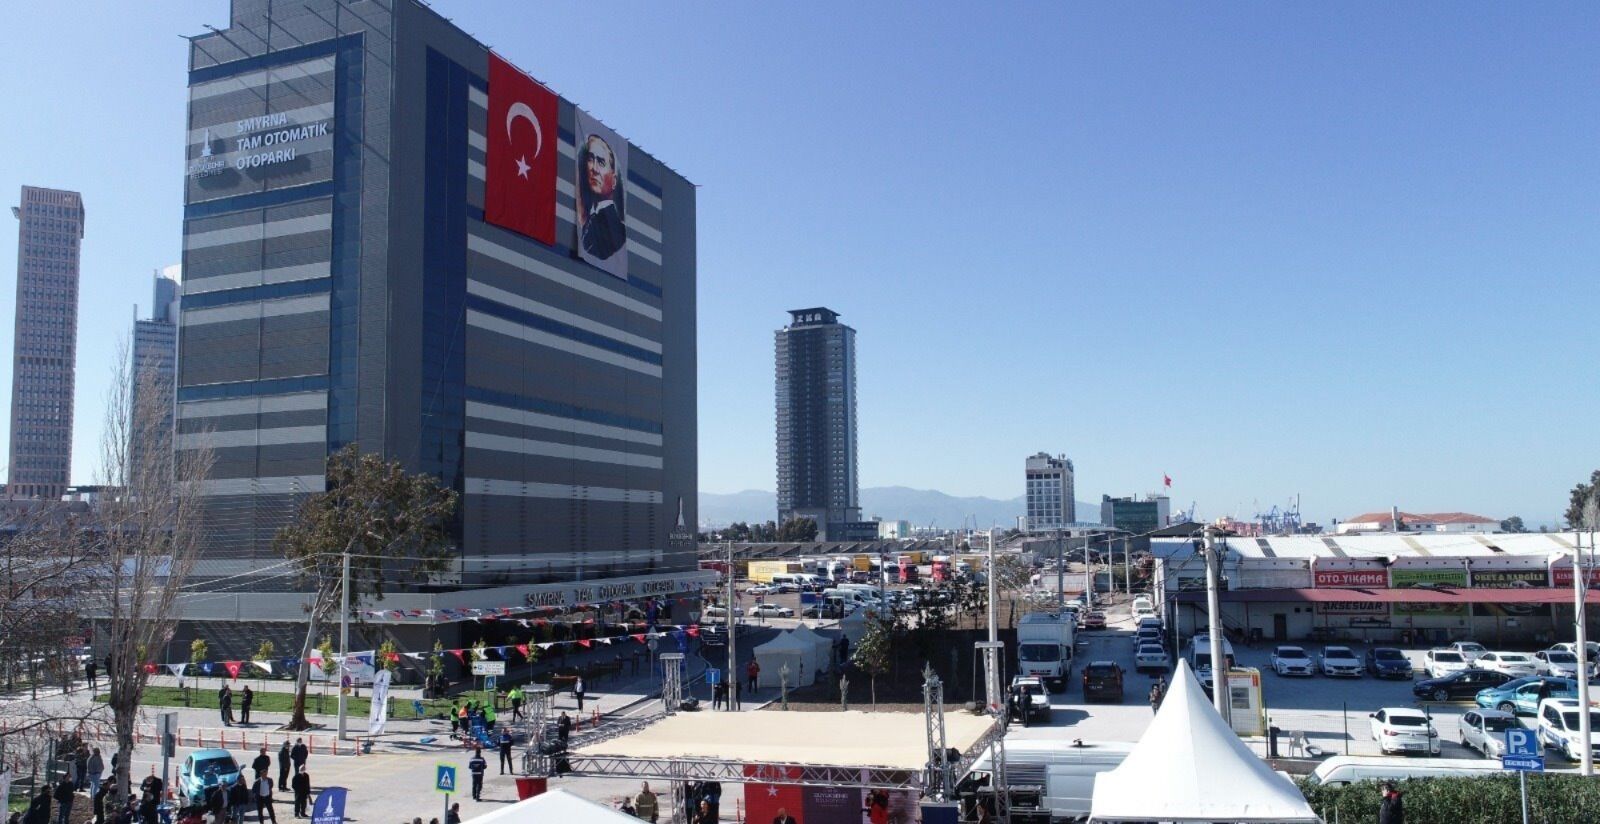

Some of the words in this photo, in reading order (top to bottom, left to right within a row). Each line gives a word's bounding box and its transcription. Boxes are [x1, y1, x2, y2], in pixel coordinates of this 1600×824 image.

[237, 112, 288, 133] SMYRNA
[237, 136, 262, 152] TAM
[265, 121, 328, 146] OTOMATİK
[236, 148, 296, 170] OTOPARKI
[1318, 574, 1339, 583] OTO
[1343, 574, 1384, 583] YIKAMA
[527, 590, 565, 607] SMYRNA
[575, 587, 594, 602] TAM
[1509, 731, 1527, 753] P
